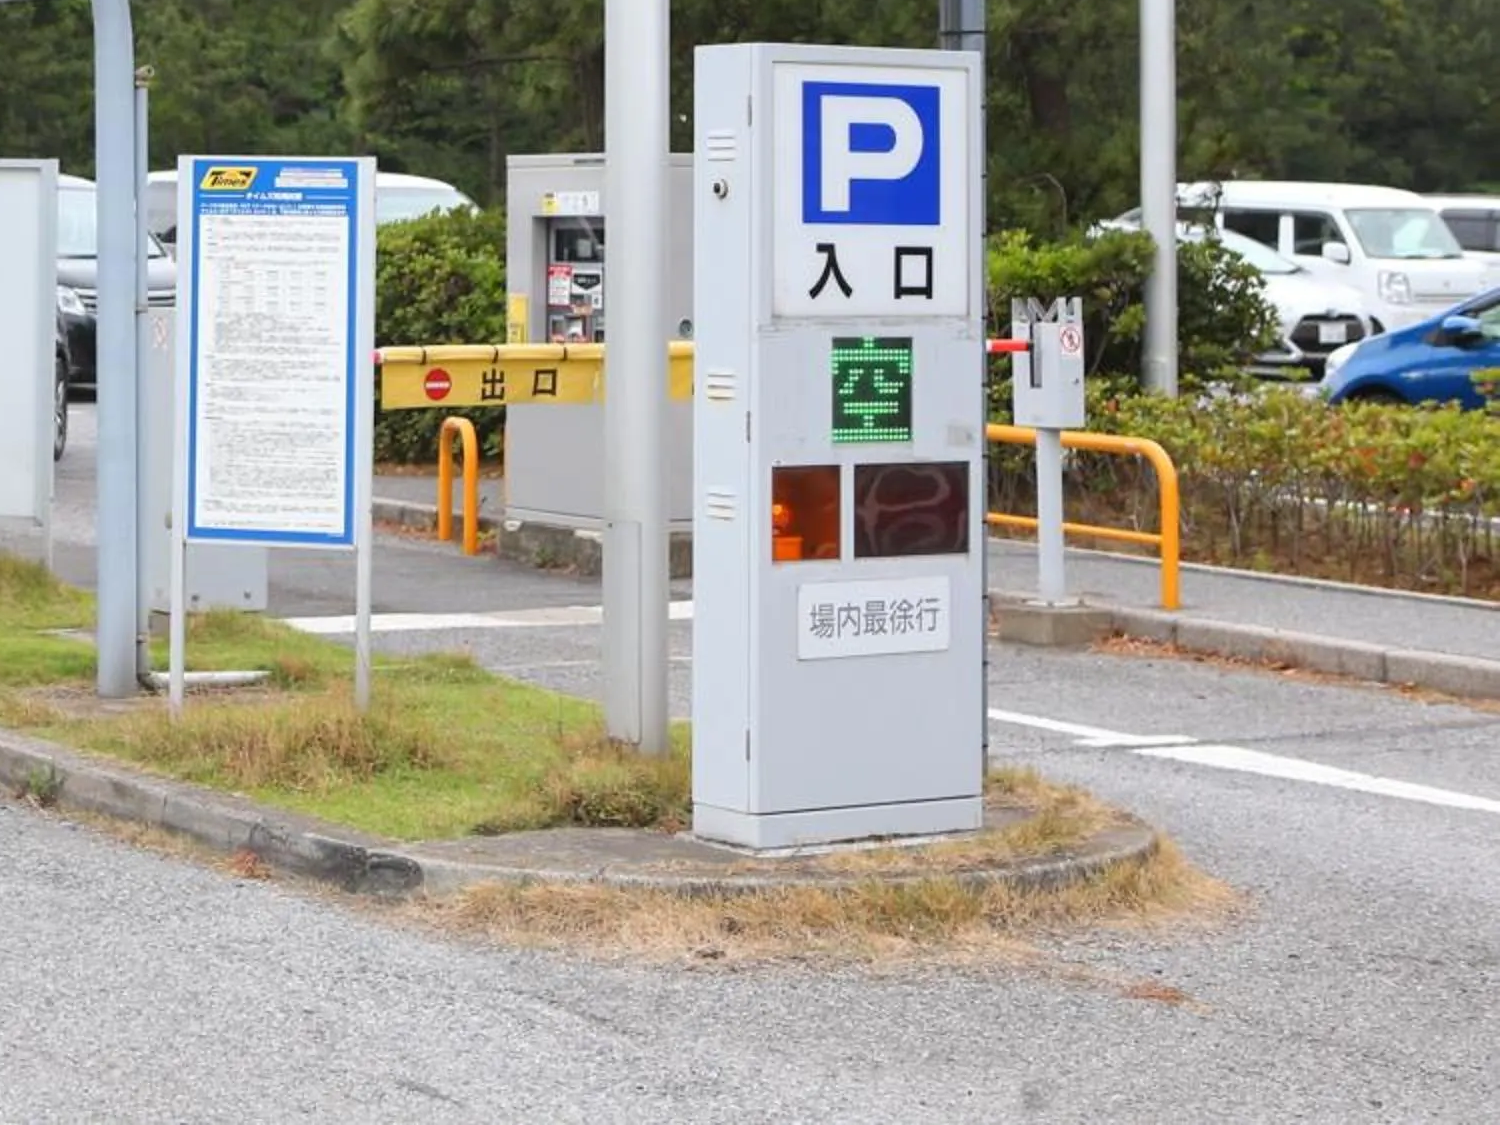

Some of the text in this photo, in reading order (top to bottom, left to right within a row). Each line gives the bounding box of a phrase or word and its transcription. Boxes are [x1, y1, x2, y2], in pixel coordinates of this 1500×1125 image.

[821, 95, 923, 212] P
[809, 243, 933, 300] 入口
[481, 369, 558, 402] 出口
[833, 340, 912, 442] 空
[809, 598, 939, 639] 場内最徐行
